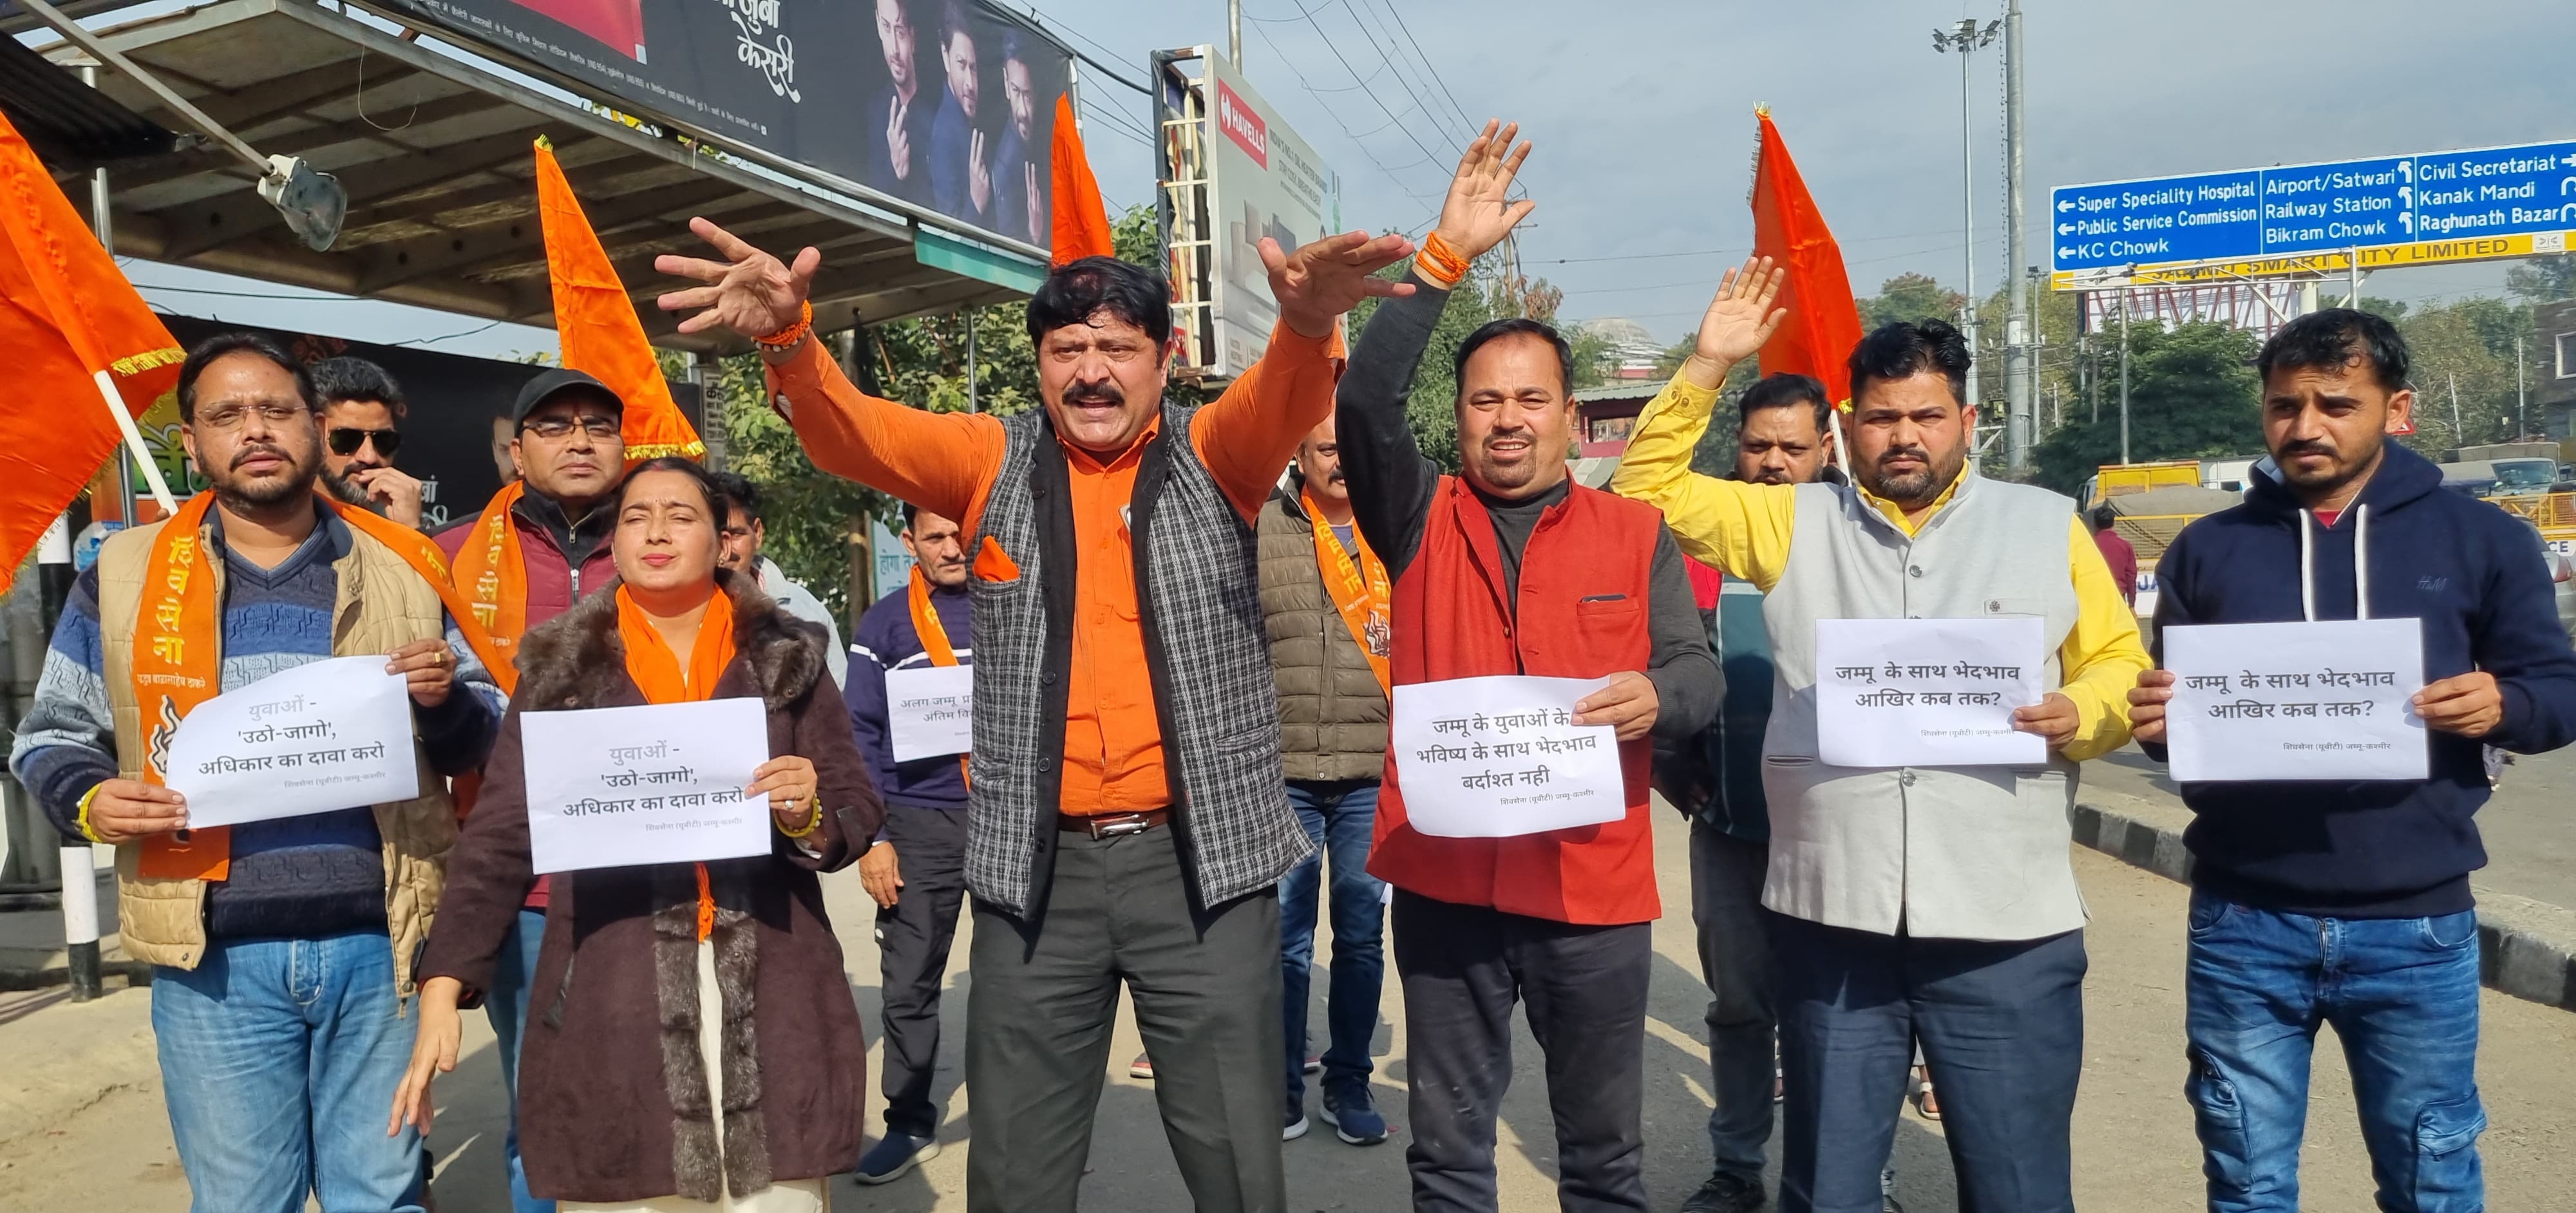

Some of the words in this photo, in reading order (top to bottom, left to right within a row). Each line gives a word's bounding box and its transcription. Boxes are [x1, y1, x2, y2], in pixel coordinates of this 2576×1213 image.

[730, 11, 801, 103] केसरी
[1232, 107, 1265, 155] HAVELLS
[2420, 163, 2456, 181] Civil
[2461, 154, 2556, 178] Secretariat
[2266, 169, 2395, 196] Airport/Satwari
[2420, 187, 2474, 206] Kanak
[2481, 182, 2535, 201] Mandi
[2078, 196, 2117, 213] Super
[2122, 187, 2193, 210] Speciality
[2198, 181, 2255, 202] Hospital
[2266, 201, 2327, 219] Railway
[2333, 196, 2391, 213] Station
[2078, 218, 2117, 236] Public
[2123, 214, 2172, 232] Service
[2178, 208, 2257, 227] Commission
[2266, 227, 2324, 243] Bikram
[2328, 220, 2386, 239] Chowk
[2420, 209, 2505, 233] Raghunath
[2512, 207, 2559, 223] Bazar
[2078, 243, 2105, 259] KC
[2110, 238, 2169, 257] Chowk
[2412, 240, 2509, 259] LIMITED
[1835, 666, 1877, 684] जम्मू
[1884, 661, 1902, 679] के
[1908, 665, 1947, 679] साथ
[1953, 661, 2021, 680] भेदभाव
[2184, 675, 2231, 694] जम्मू
[2239, 670, 2260, 689] के
[2265, 673, 2309, 688] साथ
[2316, 668, 2396, 688] भेदभाव
[249, 695, 305, 720] युवाओं
[900, 699, 929, 708] अलग
[932, 696, 958, 707] जम्मू
[1855, 688, 1915, 708] आखिर
[1920, 692, 1953, 706] कब
[1958, 691, 2001, 706] तक?
[2208, 699, 2277, 719] आखिर
[2281, 702, 2318, 718] कब
[2324, 700, 2374, 717] तक?
[923, 710, 954, 722] अंतिम
[1432, 719, 1471, 737] जम्मू
[1472, 712, 1489, 731] के
[1494, 708, 1549, 734] युवाओं
[1553, 708, 1570, 727] के
[198, 755, 272, 775] अधिकार
[278, 753, 302, 767] का
[308, 749, 346, 766] दावा
[351, 742, 385, 761] करो
[609, 740, 667, 766] युवाओं
[1416, 744, 1467, 764] भविष्य
[1471, 742, 1488, 760] के
[1493, 742, 1530, 758] साथ
[1535, 735, 1597, 755] भेदभाव
[1461, 769, 1513, 790] बर्दाश्त
[1519, 765, 1550, 787] नही
[563, 798, 636, 818] अधिकार
[641, 796, 664, 811] का
[669, 793, 706, 809] दावा
[711, 786, 743, 804] करो
